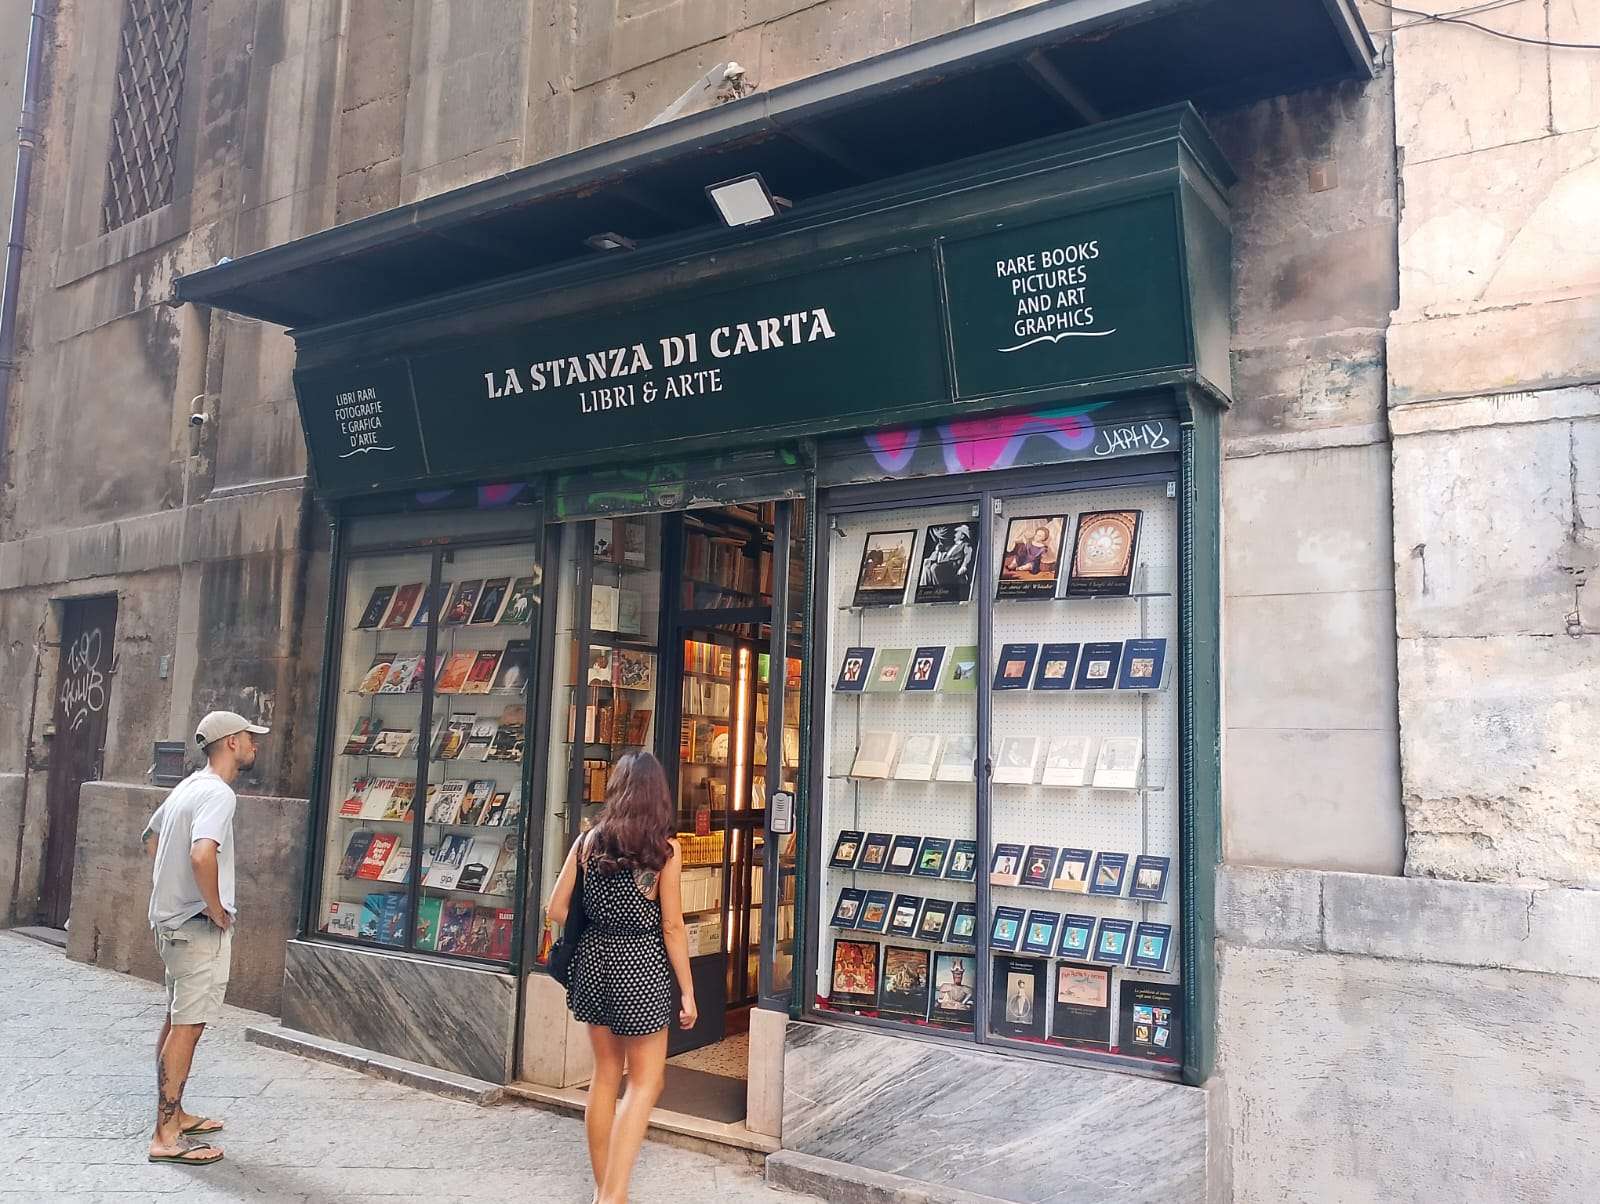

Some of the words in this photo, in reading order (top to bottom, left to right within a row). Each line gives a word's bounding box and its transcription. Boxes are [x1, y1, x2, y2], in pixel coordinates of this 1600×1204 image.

[996, 254, 1036, 278] RARE
[1041, 240, 1099, 268] BOOKS
[1012, 265, 1087, 295] PICTURES
[1017, 294, 1052, 316] AND
[1056, 287, 1086, 308] ART
[1014, 307, 1094, 337] GRAPHICS
[484, 368, 523, 399] LA
[530, 343, 652, 391] STANZA
[659, 333, 698, 368] DI
[709, 308, 836, 359] CARTA
[336, 391, 356, 406] LIBRI
[357, 387, 376, 402] RARI
[579, 384, 635, 414] LIBRI
[642, 381, 659, 404] &
[664, 368, 723, 400] ARTE
[335, 401, 383, 421] FOTOGRAFIE
[341, 422, 348, 434] E
[348, 416, 382, 433] GRAFICA
[350, 431, 378, 447] D'ARTE
